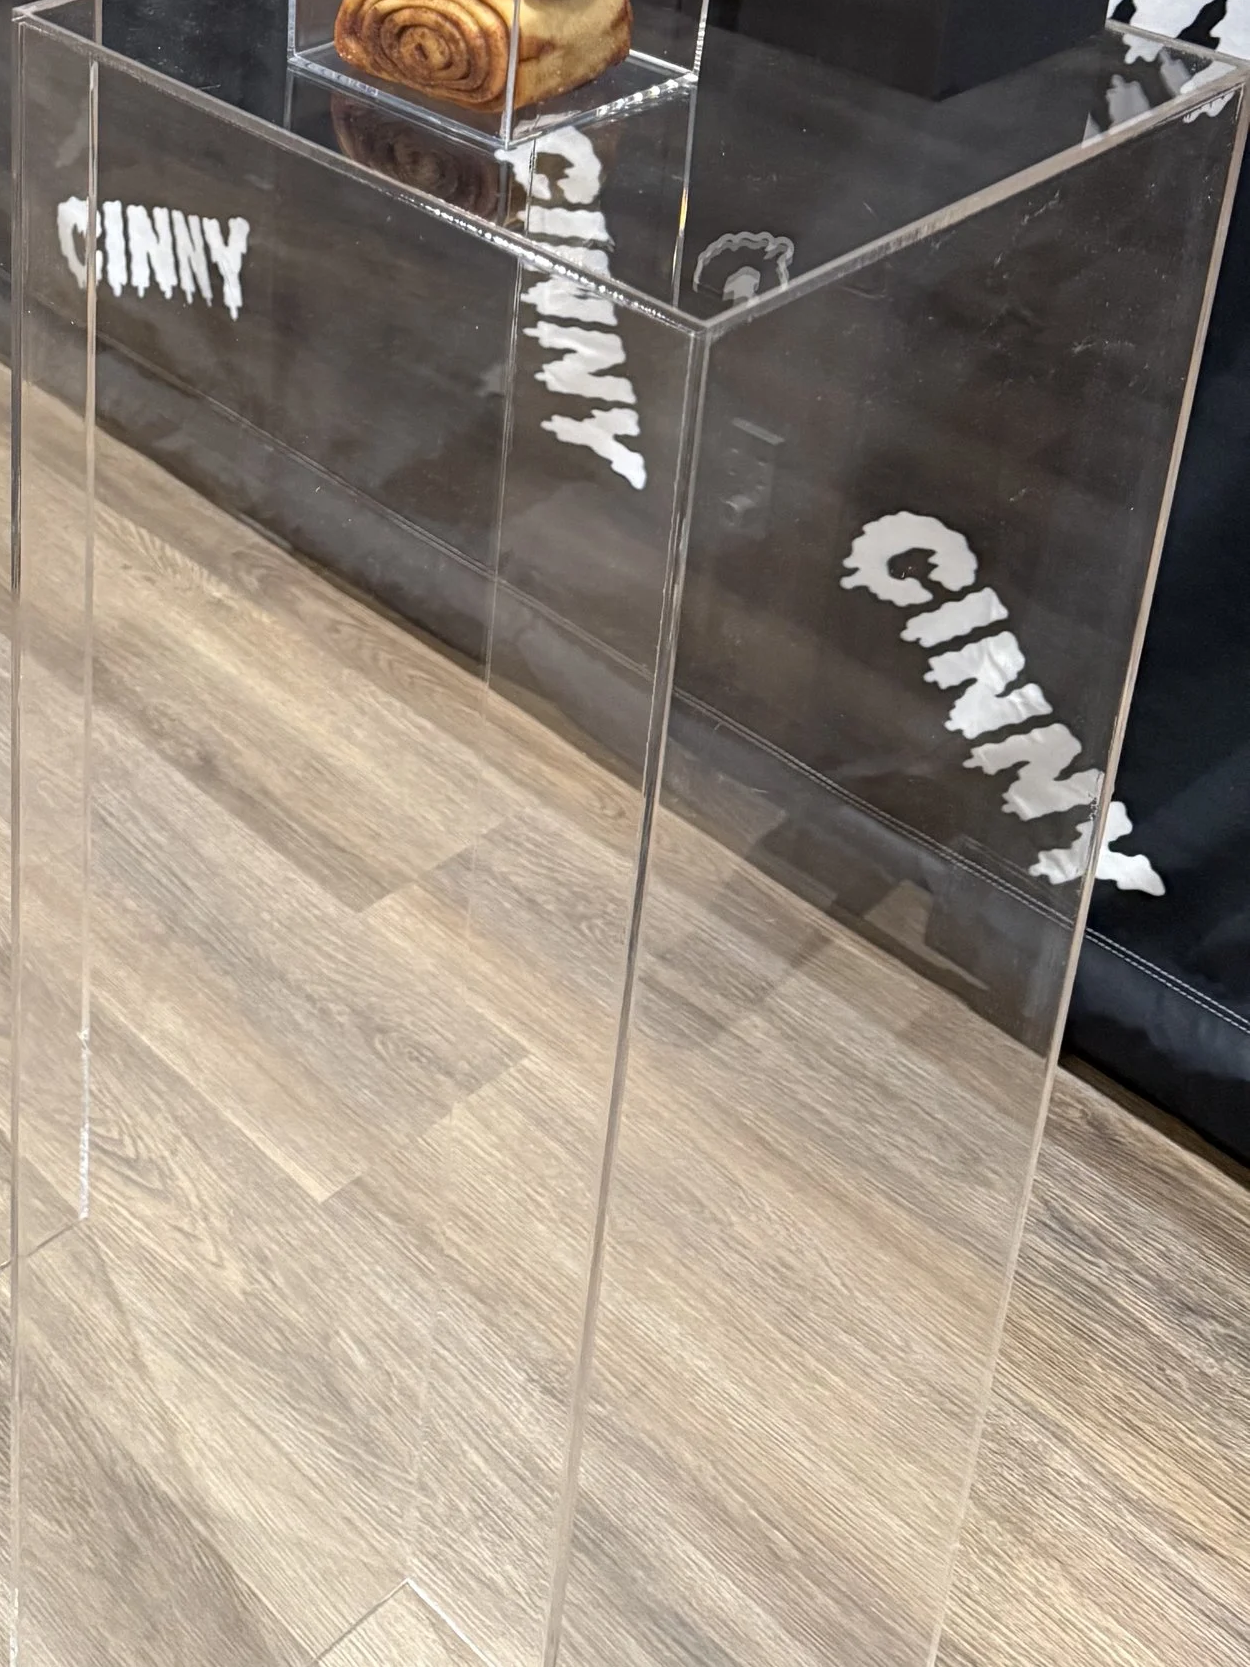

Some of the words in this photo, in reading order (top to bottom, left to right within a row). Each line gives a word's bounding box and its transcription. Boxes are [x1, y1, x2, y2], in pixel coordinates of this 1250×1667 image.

[57, 197, 250, 322] CINNY
[494, 119, 648, 491] CINNY
[841, 511, 1166, 896] CINNY
